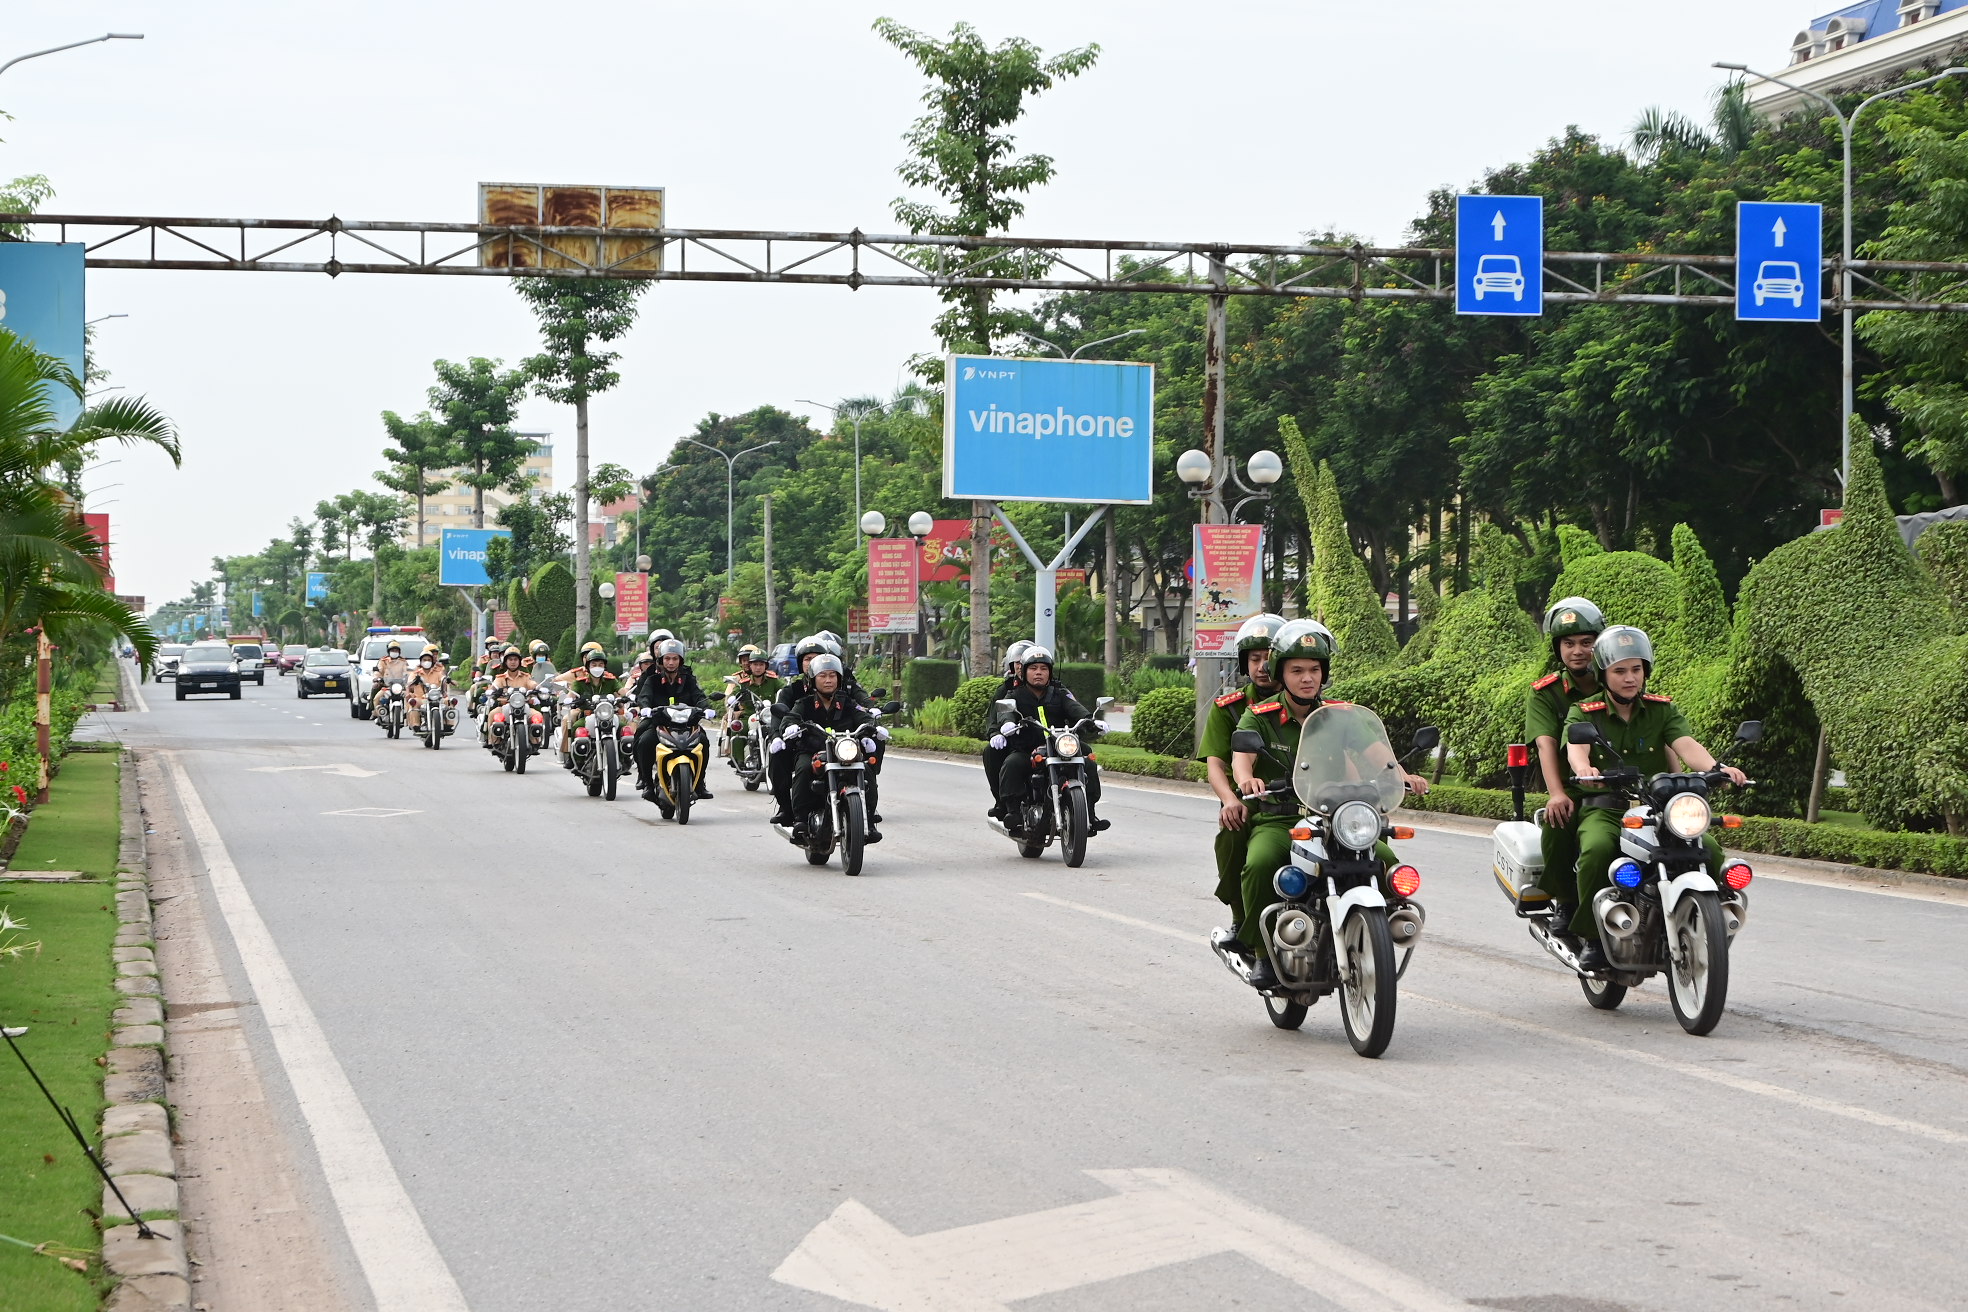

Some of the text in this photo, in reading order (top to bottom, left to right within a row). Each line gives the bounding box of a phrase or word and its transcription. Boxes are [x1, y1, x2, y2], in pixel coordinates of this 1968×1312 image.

[978, 370, 1016, 380] VNPT
[968, 403, 1134, 440] vinaphone
[448, 547, 486, 562] vinap
